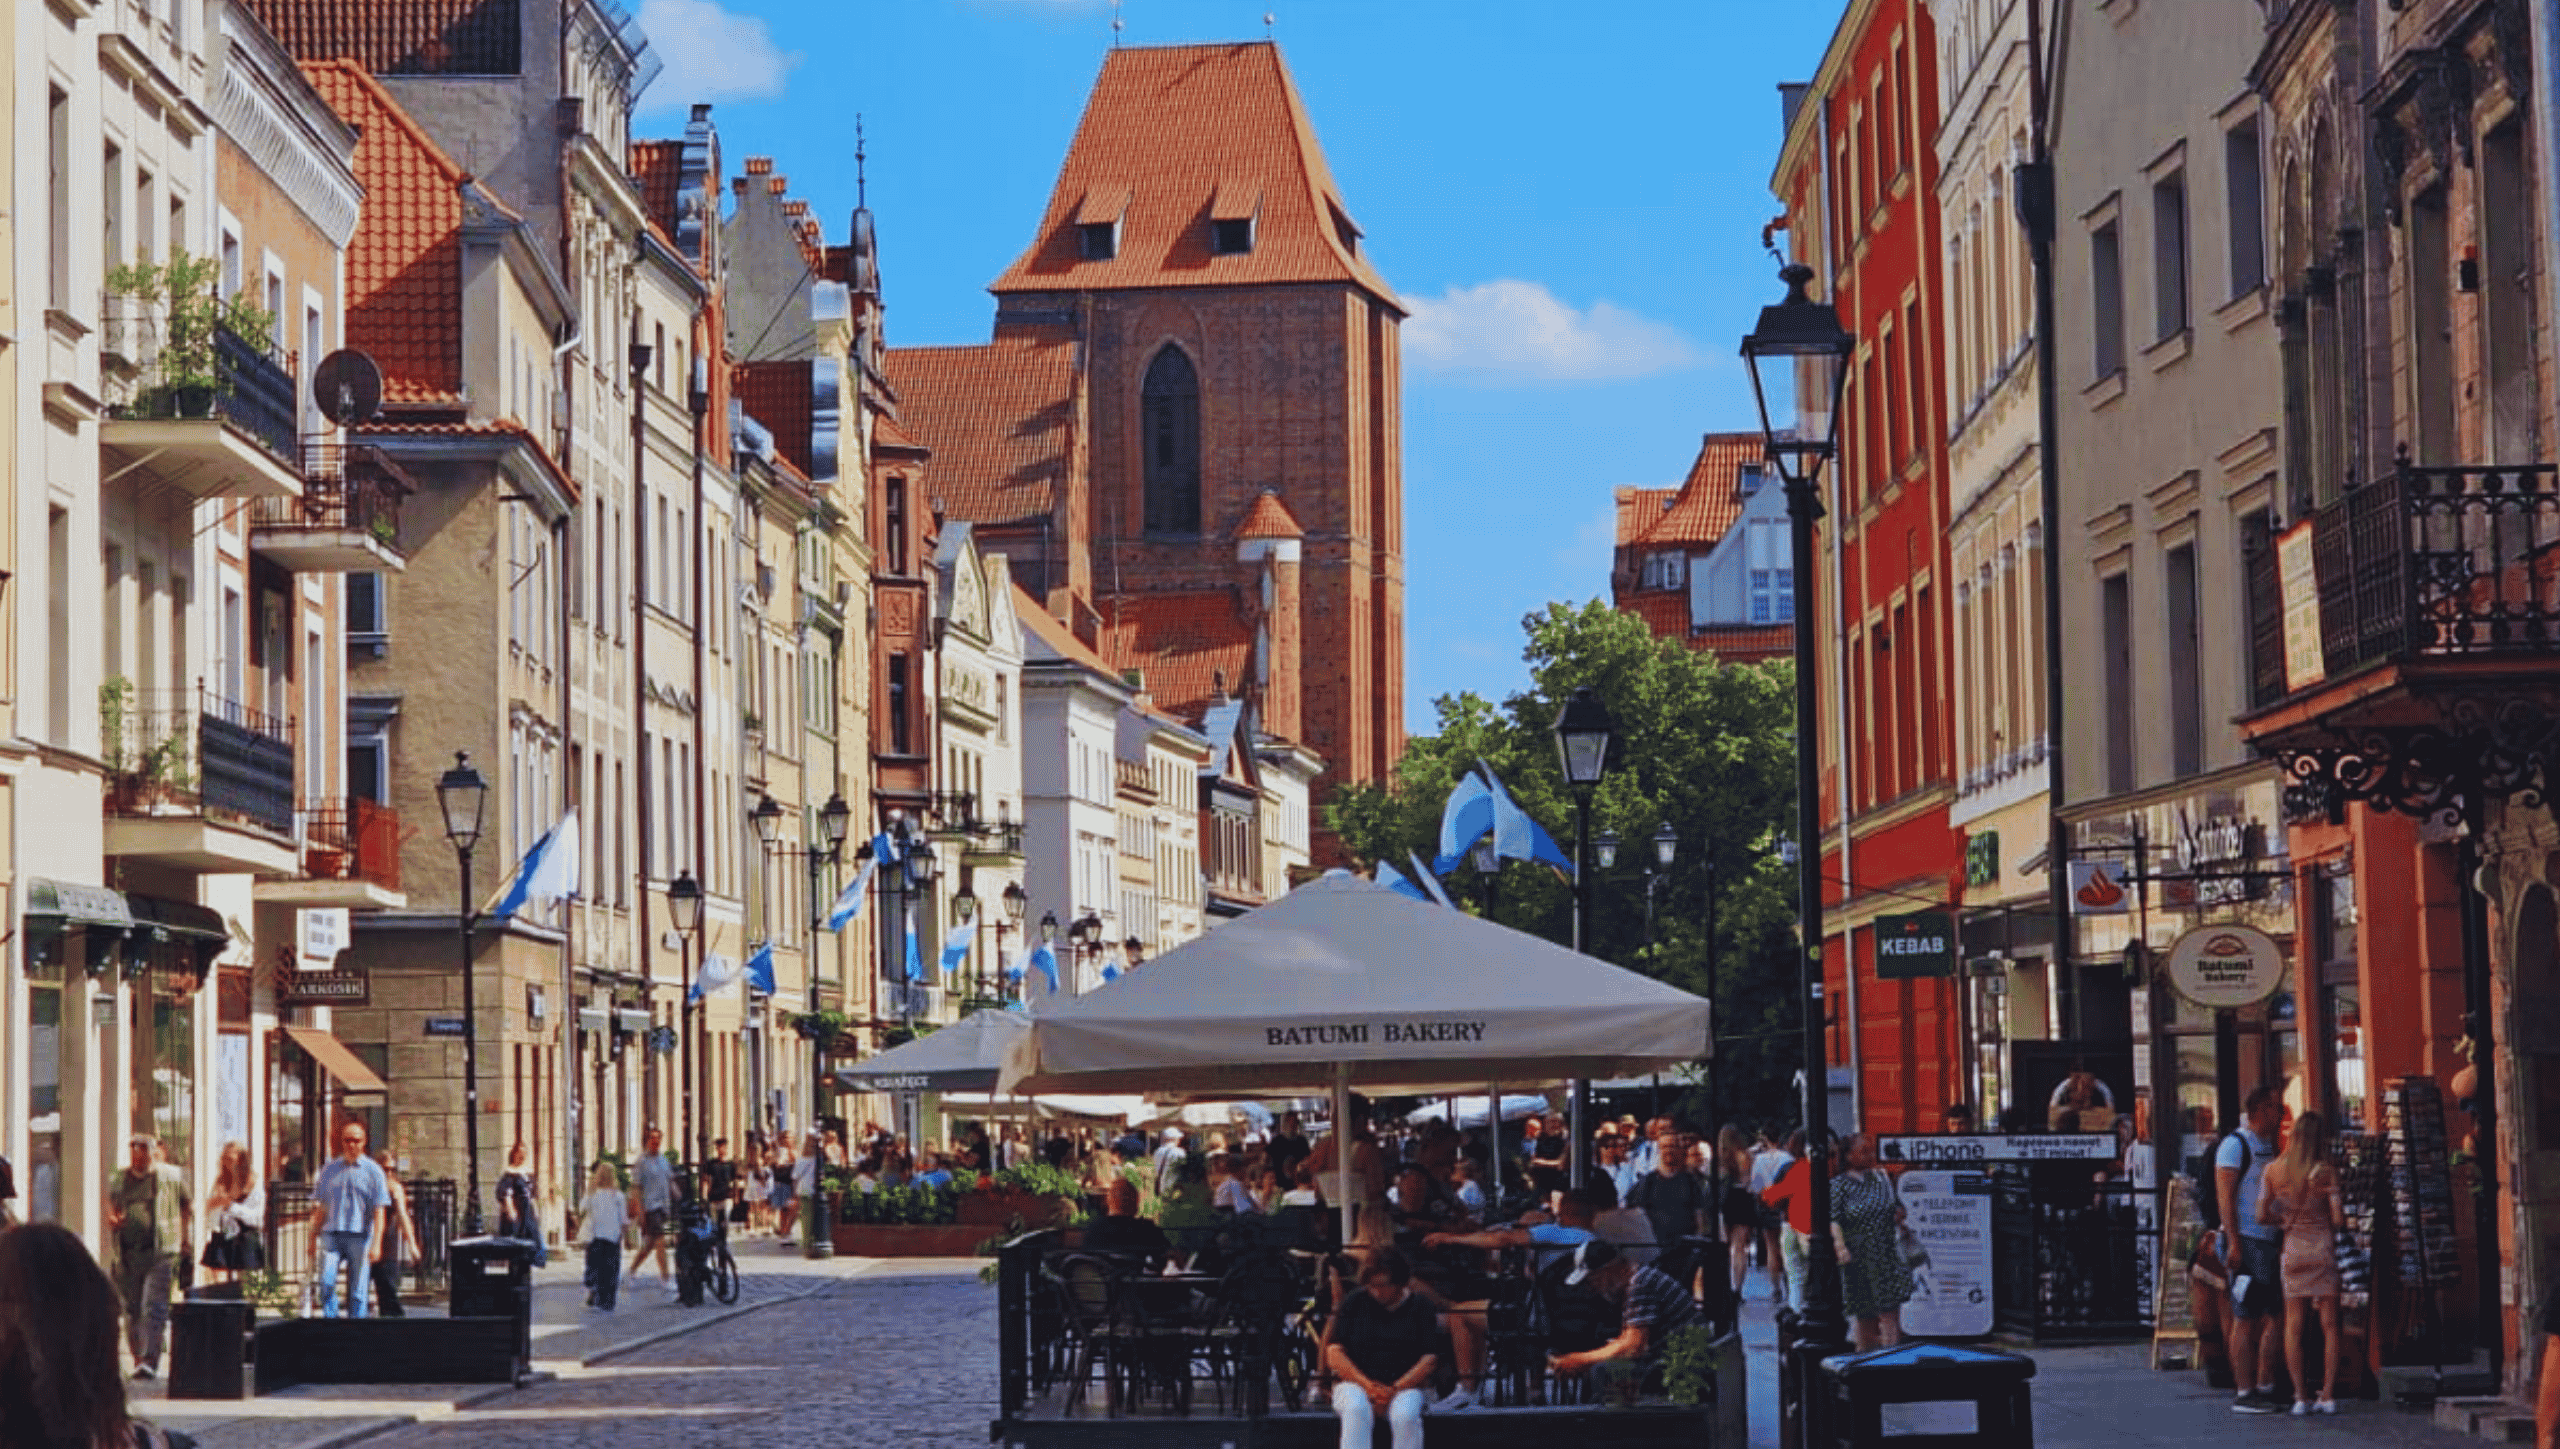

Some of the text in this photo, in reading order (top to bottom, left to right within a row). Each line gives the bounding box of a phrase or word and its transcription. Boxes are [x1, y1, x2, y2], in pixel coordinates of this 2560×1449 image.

[1881, 936, 1944, 955] KEBAB
[2198, 959, 2252, 972] Batumi
[1266, 1022, 1487, 1045] BATUMI BAKERY
[1911, 1140, 1985, 1161] iPhone
